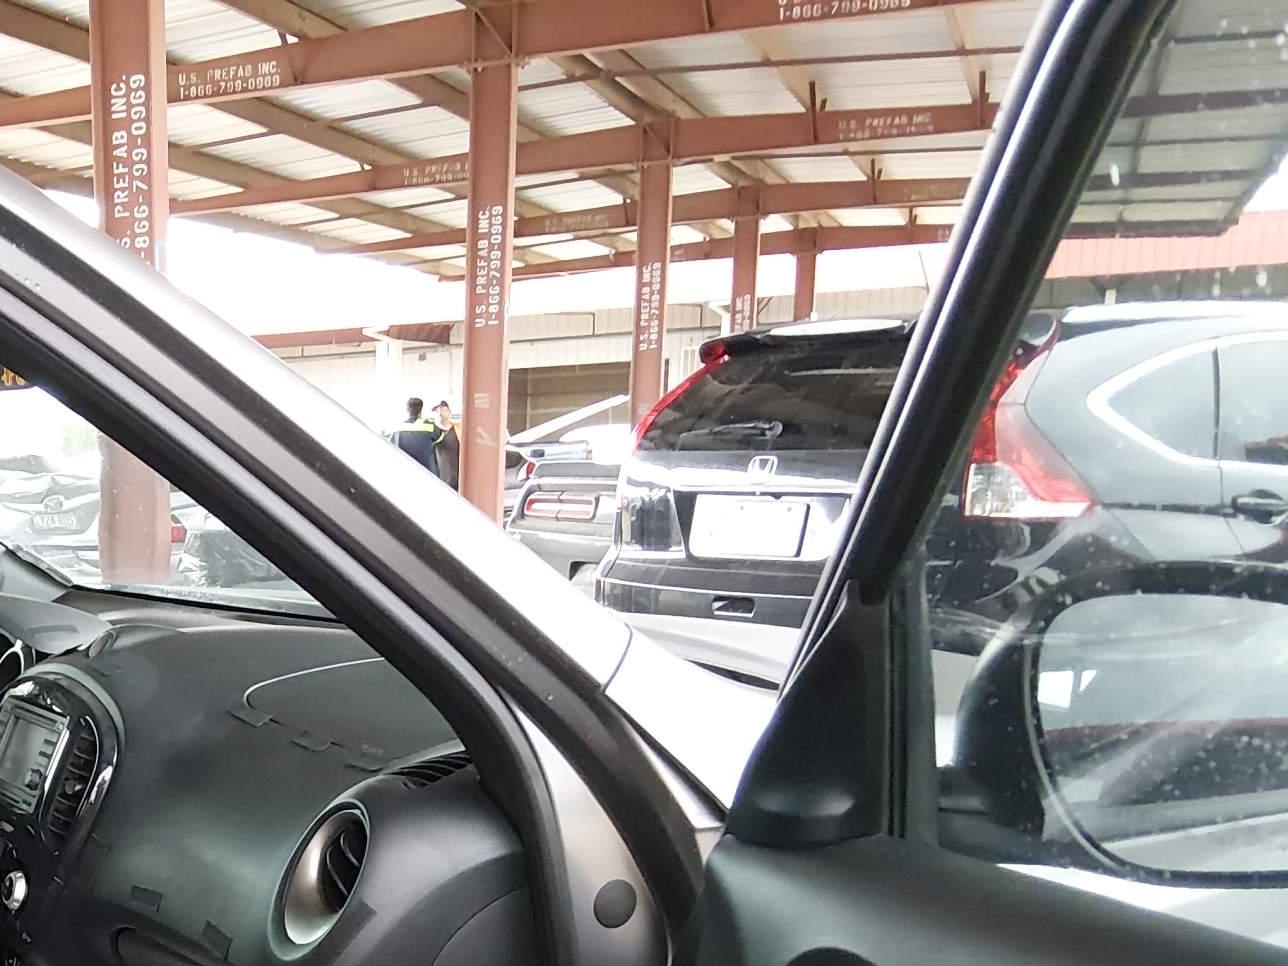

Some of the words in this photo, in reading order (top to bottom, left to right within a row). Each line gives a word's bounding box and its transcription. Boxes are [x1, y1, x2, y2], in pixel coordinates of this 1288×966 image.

[111, 75, 127, 119] INC.
[207, 64, 252, 82] PREFAB
[258, 60, 281, 76] INC.
[113, 130, 129, 218] PREFAB
[130, 74, 151, 265] -866-799-0969
[478, 205, 490, 233] INC.
[476, 239, 488, 294] PREFAB
[488, 205, 503, 325] 1-866-799-0969
